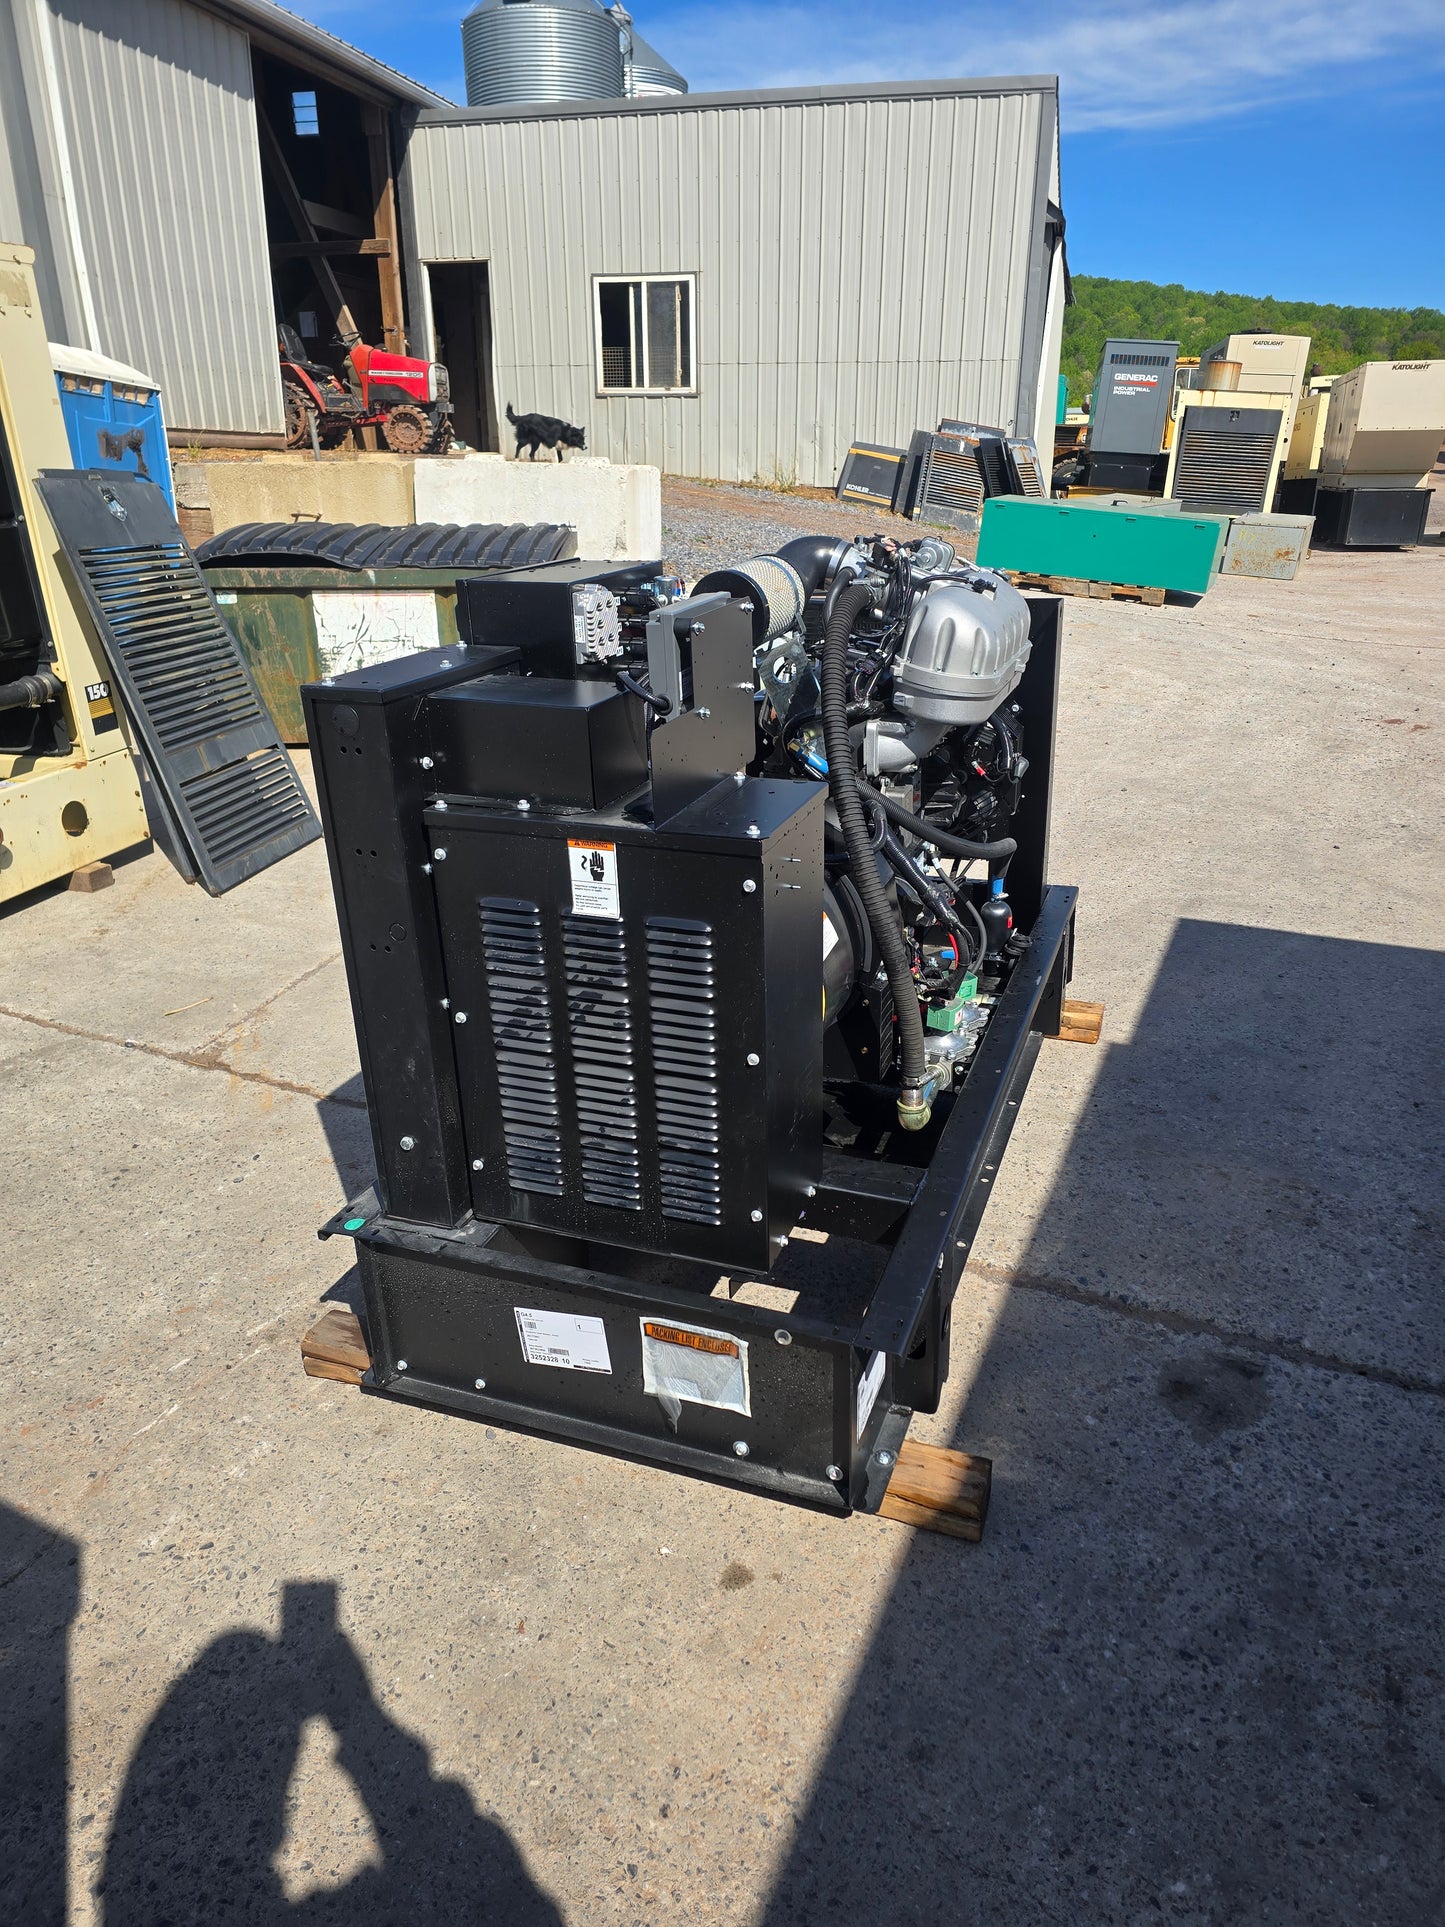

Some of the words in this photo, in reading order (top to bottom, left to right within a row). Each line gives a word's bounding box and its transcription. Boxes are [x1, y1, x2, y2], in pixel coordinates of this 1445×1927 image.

[1391, 363, 1432, 371] KATOLIGHT
[1114, 373, 1159, 382] GENERAC
[1113, 385, 1151, 393] INDUSTRIAL
[845, 483, 870, 494] KOHLER
[86, 682, 109, 701] 150
[581, 840, 608, 849] WARNING
[651, 1326, 680, 1341] PACKING
[681, 1332, 696, 1345] LIST
[530, 1353, 559, 1363] 3252328
[562, 1357, 571, 1365] 10
